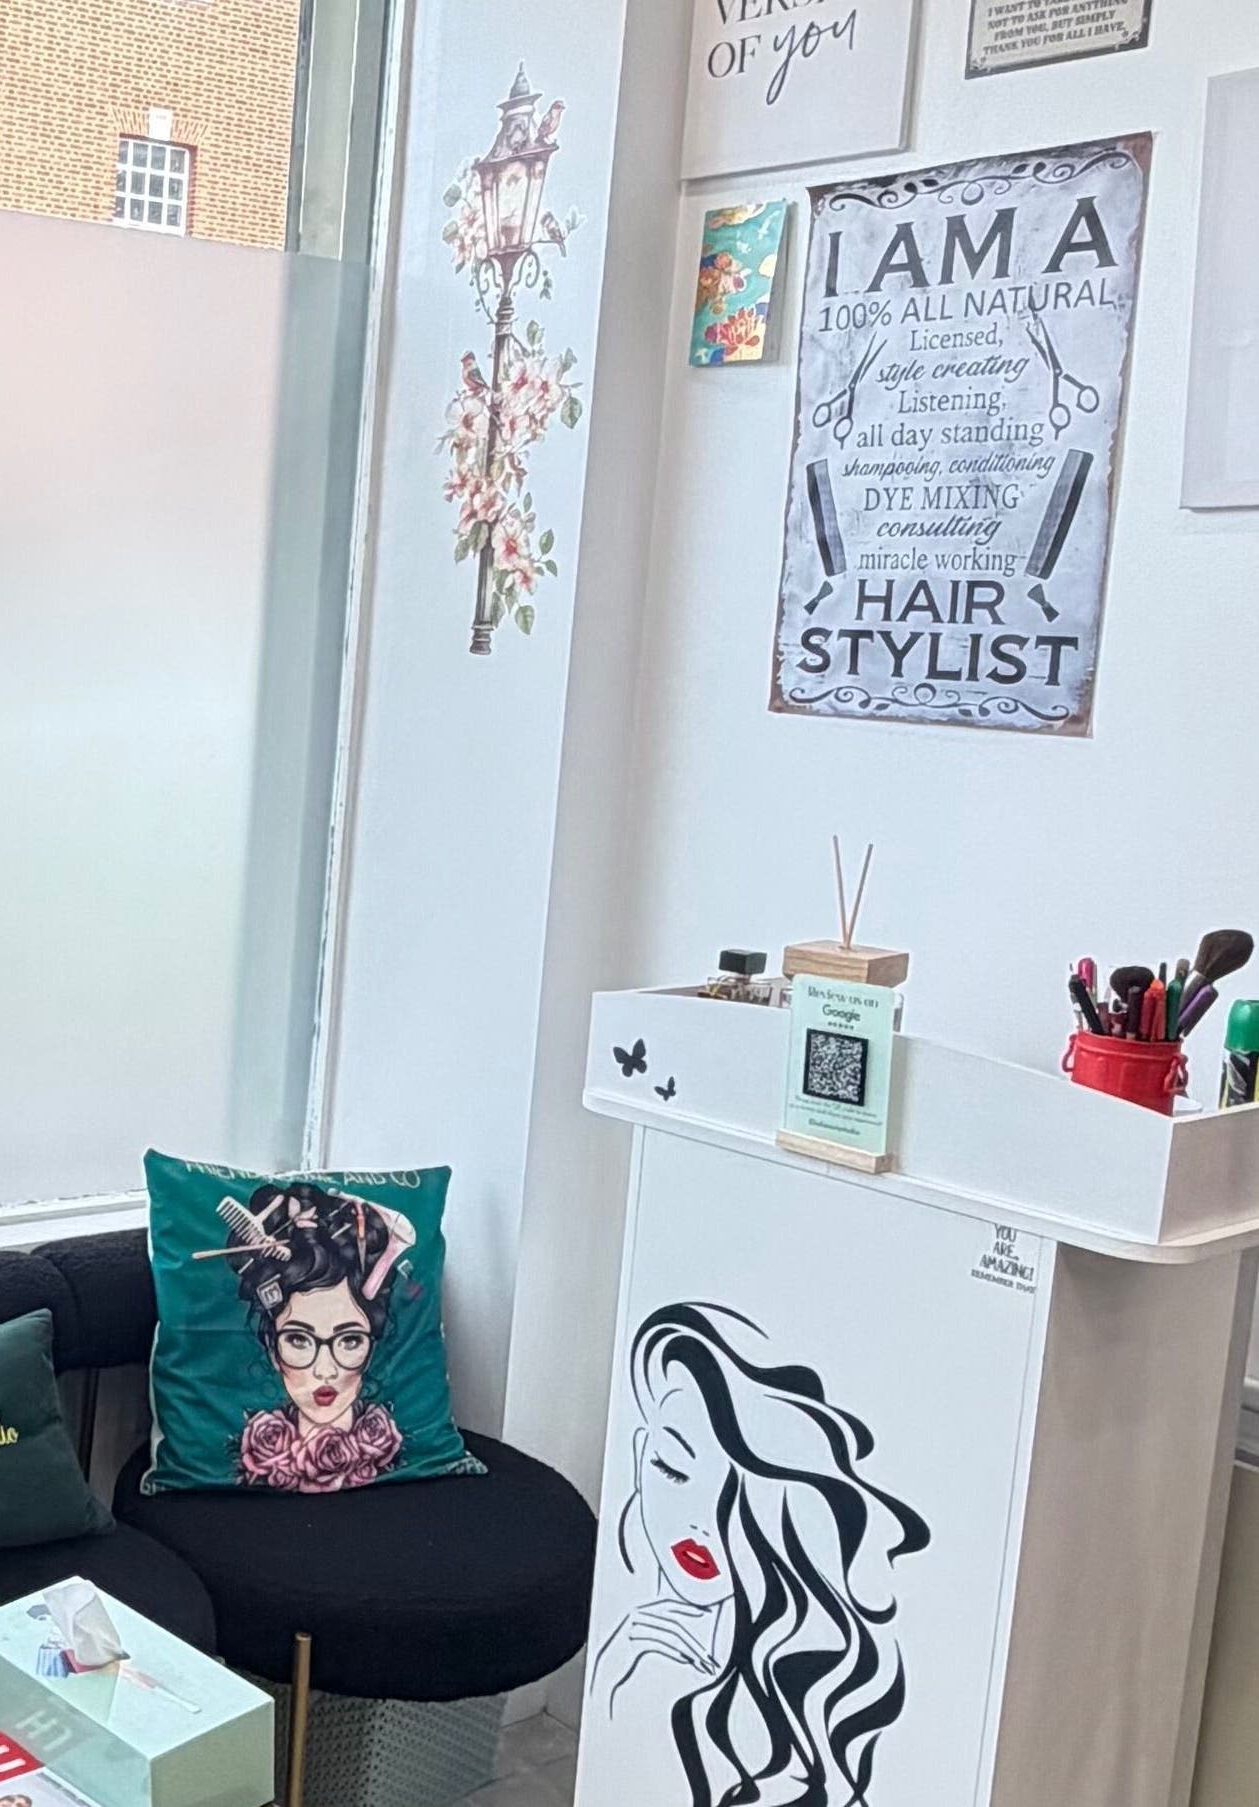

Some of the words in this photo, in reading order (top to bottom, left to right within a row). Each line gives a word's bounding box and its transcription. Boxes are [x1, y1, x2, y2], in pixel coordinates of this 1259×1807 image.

[987, 18, 1009, 30] NOT
[1011, 15, 1025, 25] TO
[1027, 10, 1046, 22] ASK
[1048, 5, 1070, 18] FOR
[994, 27, 1024, 41] FROM
[1051, 18, 1073, 31] BUT
[1075, 10, 1116, 25] SIMPLY
[707, 34, 762, 78] OF
[766, 9, 857, 105] you
[983, 41, 1019, 55] THANK
[1020, 36, 1041, 48] YOU
[1043, 33, 1064, 45] FOR
[1065, 29, 1086, 40] ALL
[823, 231, 844, 298] I
[864, 206, 1018, 294] AM
[1040, 196, 1119, 274] A
[817, 300, 892, 333] 100%
[900, 292, 954, 325] ALL
[909, 322, 1004, 352] Licensed,
[875, 359, 926, 391] style
[931, 354, 1031, 384] creating
[897, 386, 1007, 417] Listening,
[856, 423, 884, 448] all
[891, 422, 934, 452] day
[940, 416, 1045, 447] standing
[948, 452, 1057, 480] conditioning
[863, 486, 914, 511] DYE
[920, 483, 1020, 511] MIXING
[876, 514, 1004, 546] consulting
[857, 546, 929, 572] miracle
[935, 546, 1019, 578] working
[854, 578, 1007, 625] HAIR
[795, 626, 1080, 687] STYLIST
[822, 1003, 861, 1023] Google
[994, 1223, 1018, 1243] YOU
[979, 1253, 1035, 1282] AMAZING!
